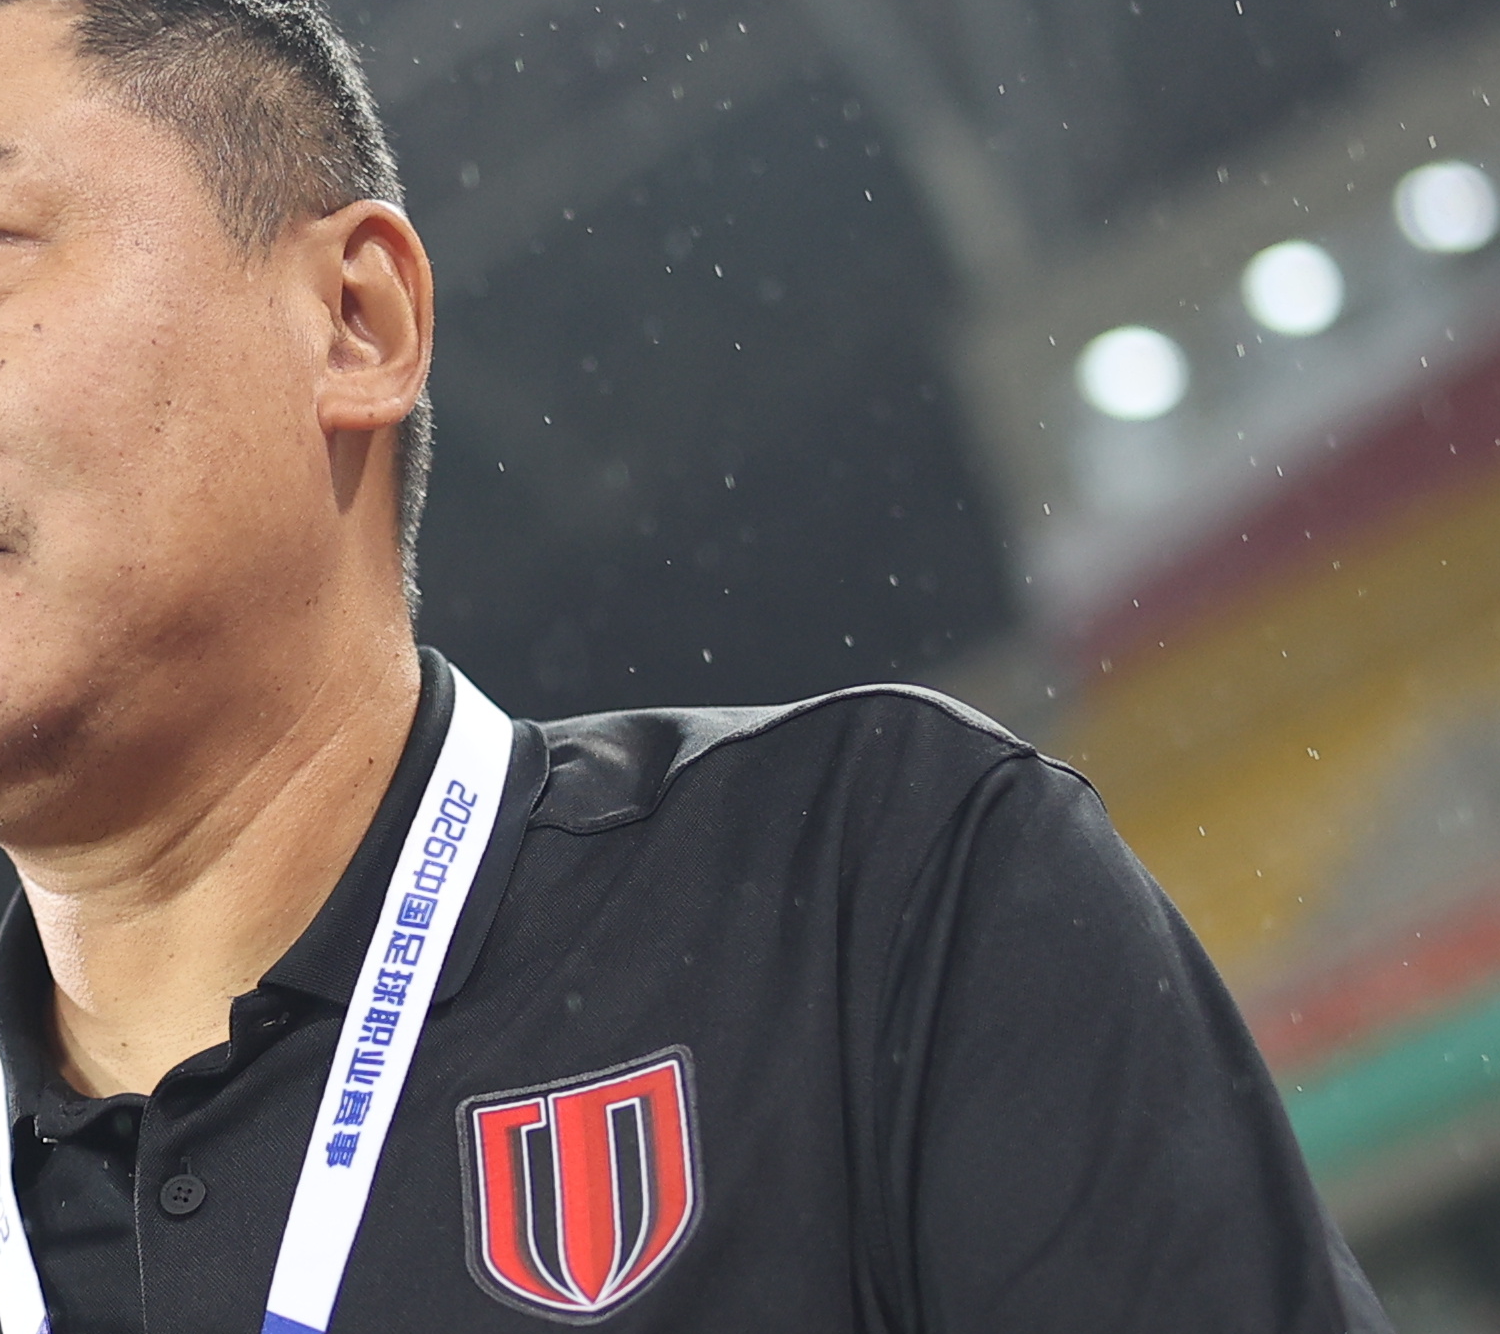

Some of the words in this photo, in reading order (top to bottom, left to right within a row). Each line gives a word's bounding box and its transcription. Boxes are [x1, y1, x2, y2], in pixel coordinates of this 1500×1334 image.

[326, 779, 478, 1168] 2026中国足球职业赛事
